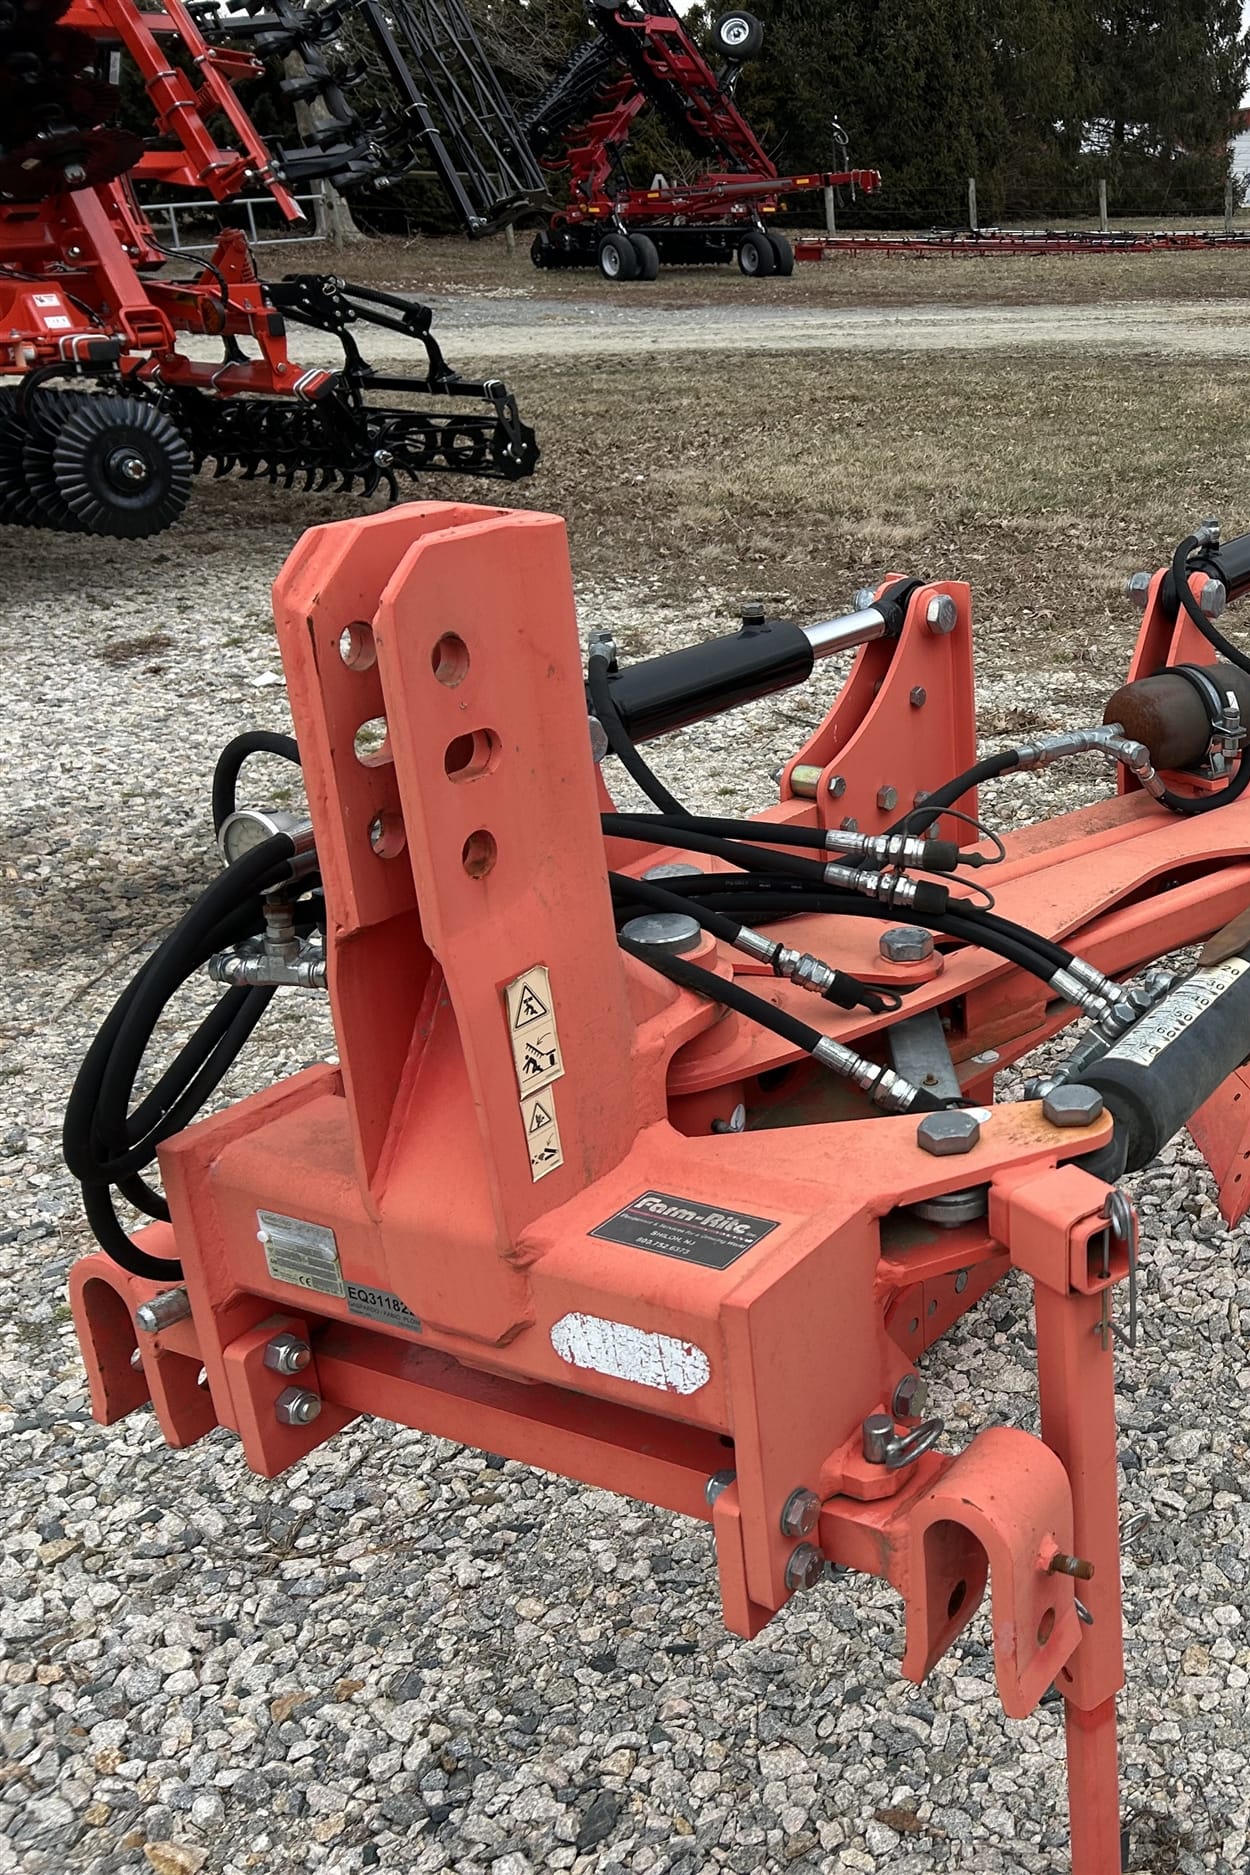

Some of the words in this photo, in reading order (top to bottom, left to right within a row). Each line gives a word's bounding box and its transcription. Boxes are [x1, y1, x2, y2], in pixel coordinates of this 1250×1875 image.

[1221, 965, 1240, 976] 20
[1207, 979, 1225, 991] 30
[1174, 1009, 1193, 1022] 50
[1156, 1026, 1177, 1038] 60
[634, 1197, 751, 1234] Farm-Rite
[347, 1286, 415, 1317] EQ31182
